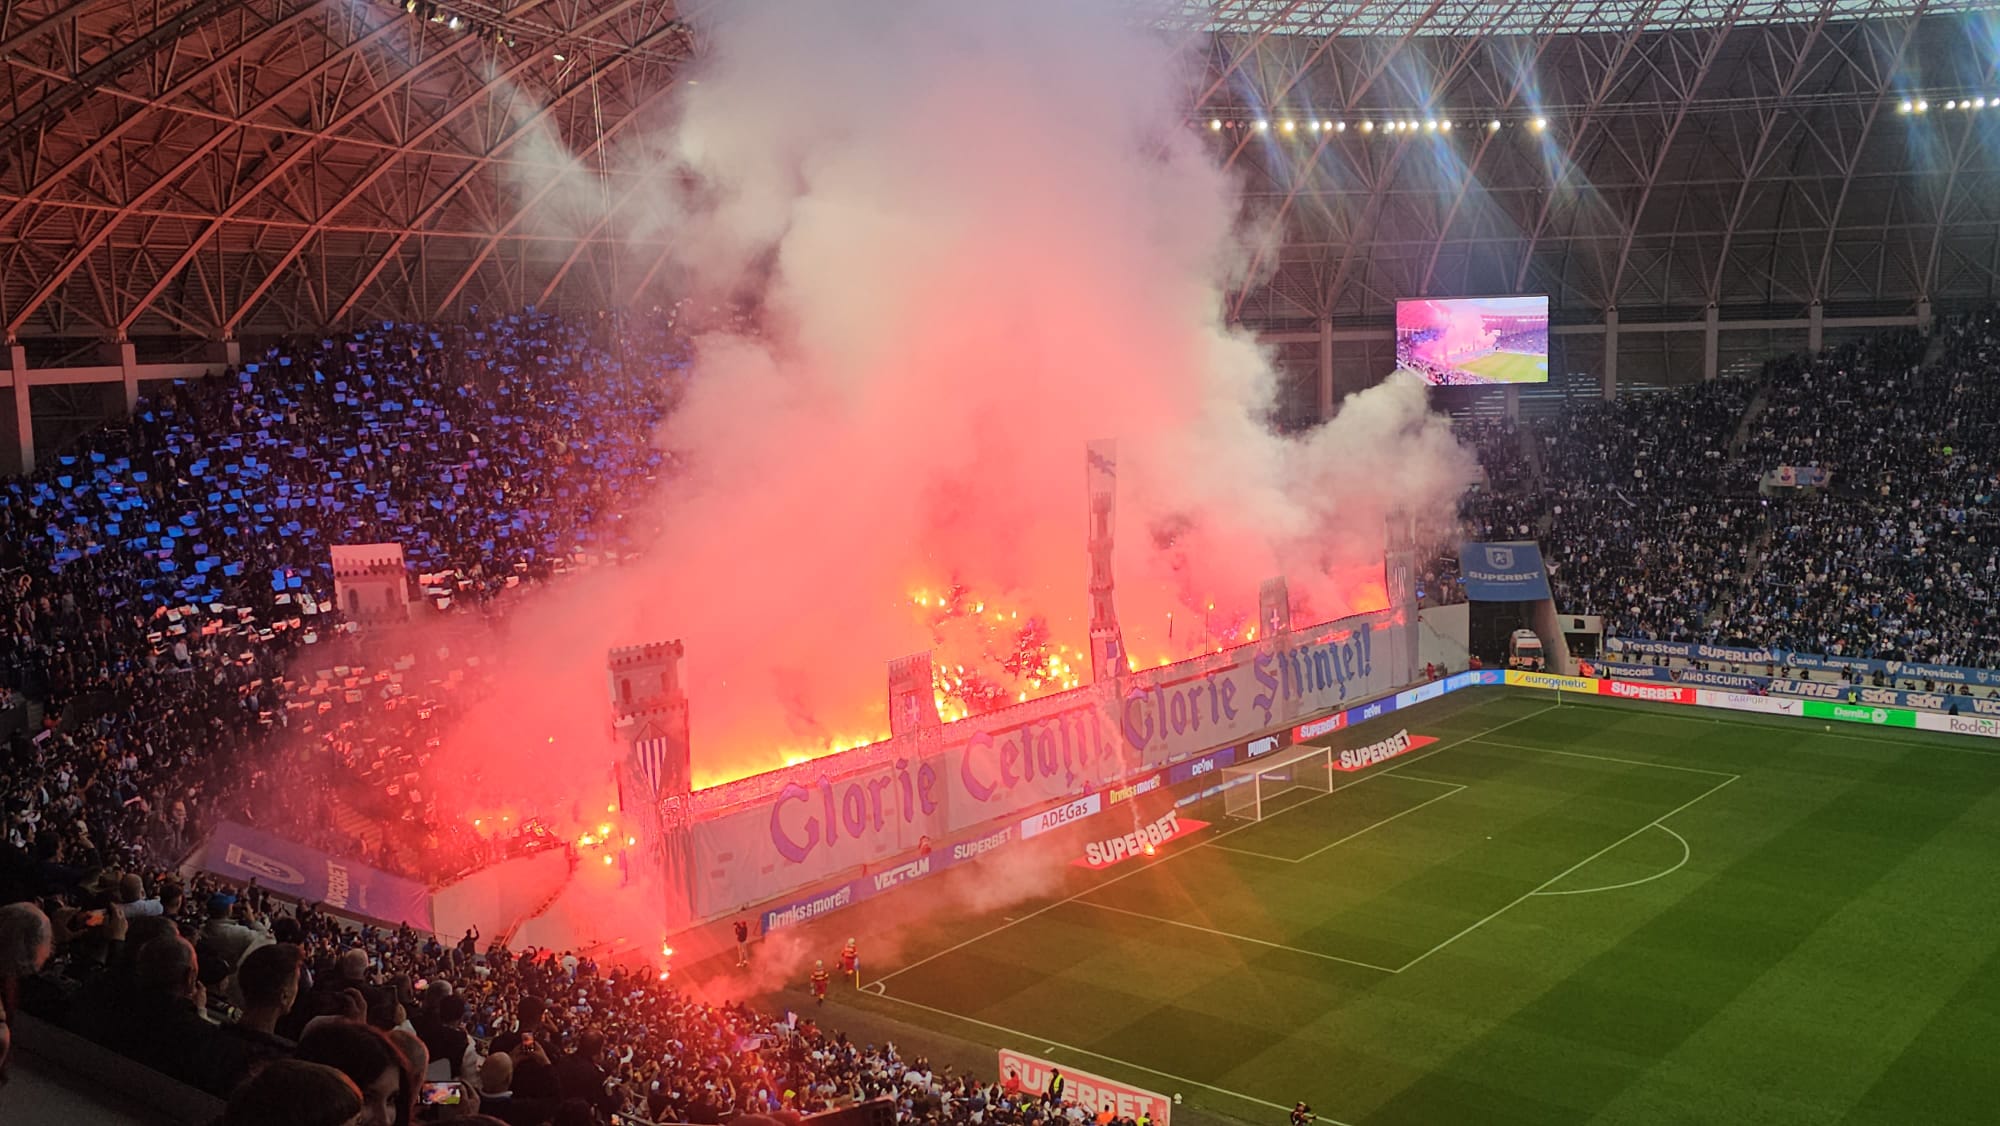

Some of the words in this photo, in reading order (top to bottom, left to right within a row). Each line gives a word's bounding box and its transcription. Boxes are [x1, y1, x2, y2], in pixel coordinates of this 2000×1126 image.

[1468, 570, 1539, 582] SUPERBET
[1624, 640, 1689, 655] TeraSteel
[1698, 645, 1774, 662] SUPERLIGA
[1525, 674, 1588, 690] eurogenetic
[1902, 666, 1916, 676] La
[1917, 667, 1965, 681] Provincia
[1611, 681, 1683, 700] SUPERBET
[1769, 678, 1840, 698] RURIS
[1861, 688, 1898, 705] SIXT
[1905, 693, 1945, 710] SIXT
[1300, 714, 1341, 738] SUPERBET
[1340, 728, 1412, 769] SUPERBET
[769, 757, 939, 864] Glorie
[1122, 672, 1239, 750] Glorie
[1041, 801, 1088, 831] ADEGas
[953, 825, 1012, 860] SUPERBET
[1086, 809, 1180, 866] SUPERBET
[874, 856, 930, 891] VECTRUM
